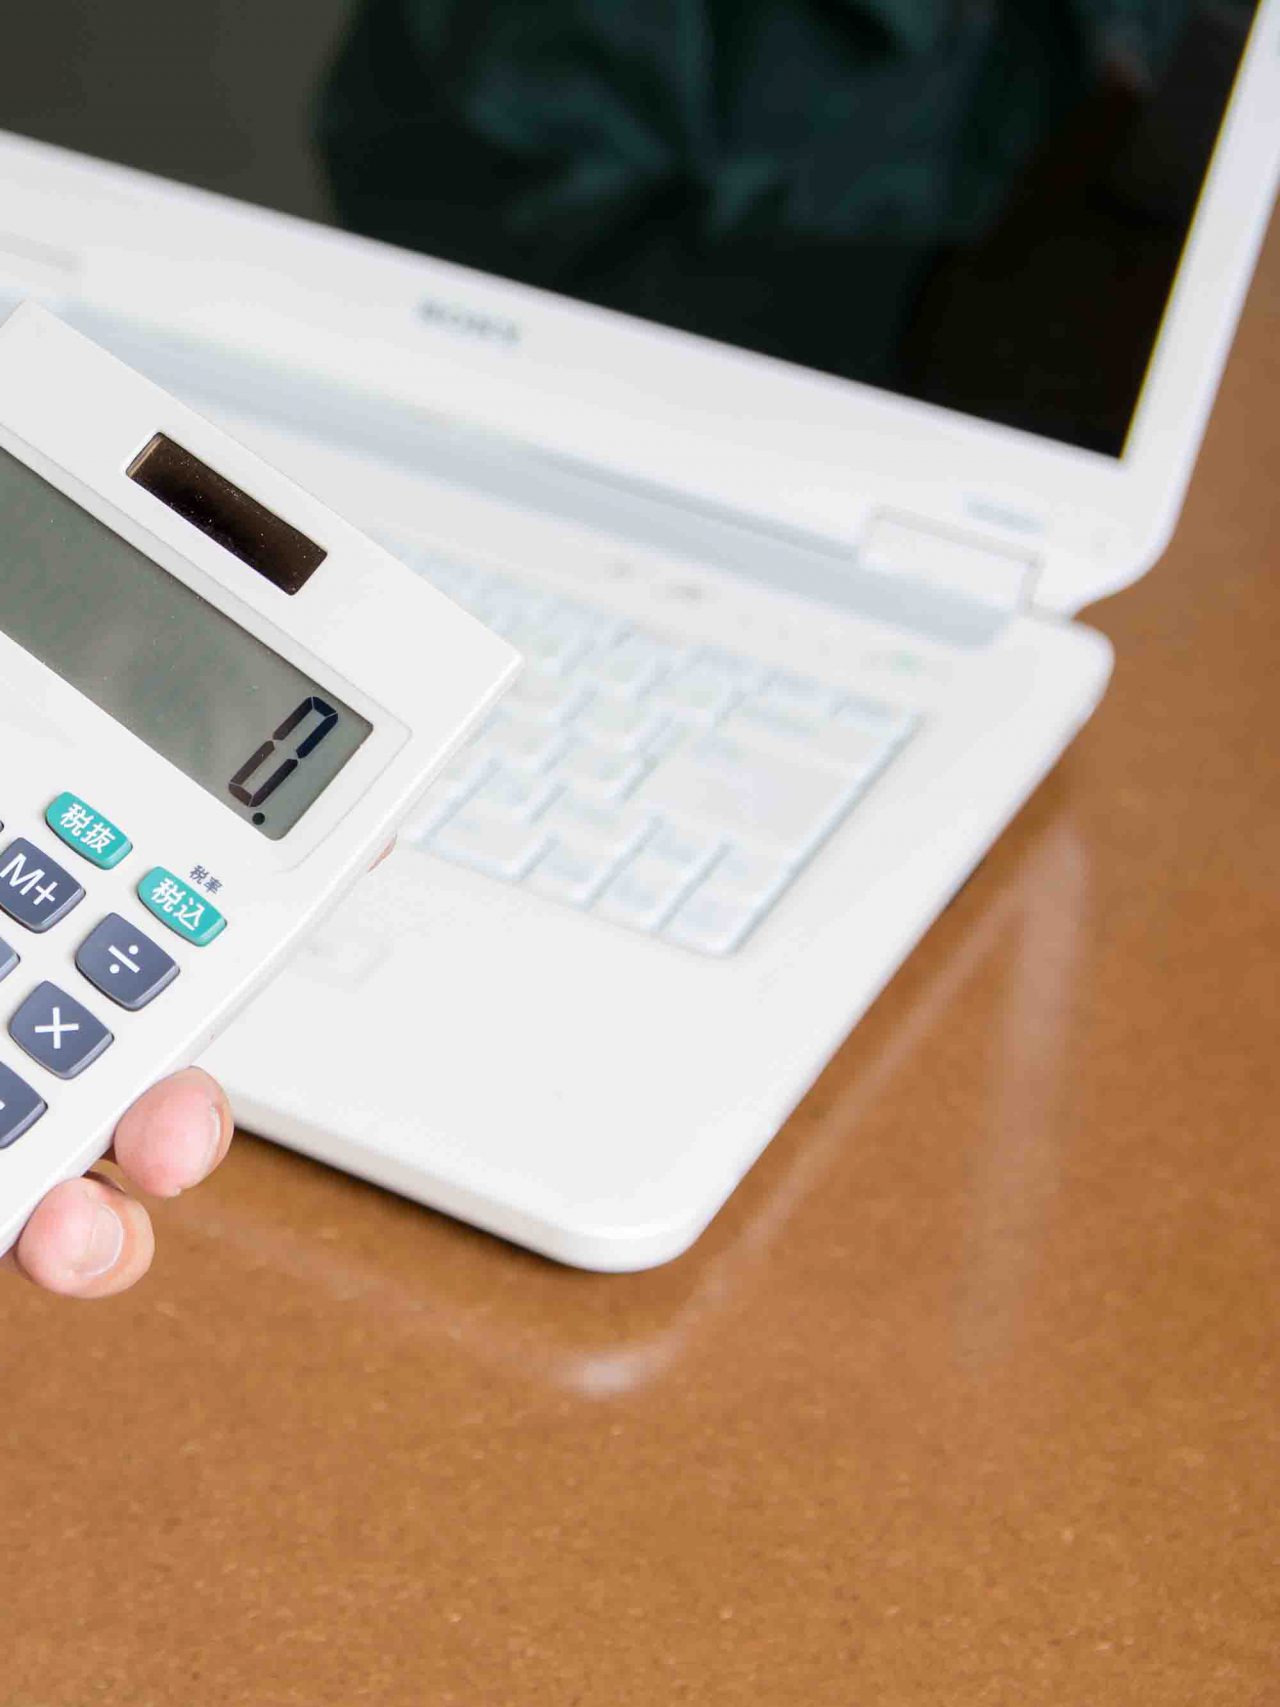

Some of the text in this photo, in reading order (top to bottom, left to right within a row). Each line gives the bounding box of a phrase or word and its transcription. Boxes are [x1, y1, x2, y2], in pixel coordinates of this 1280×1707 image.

[59, 802, 116, 854] 税抜
[150, 877, 206, 932] 税込
[188, 864, 223, 895] 税率
